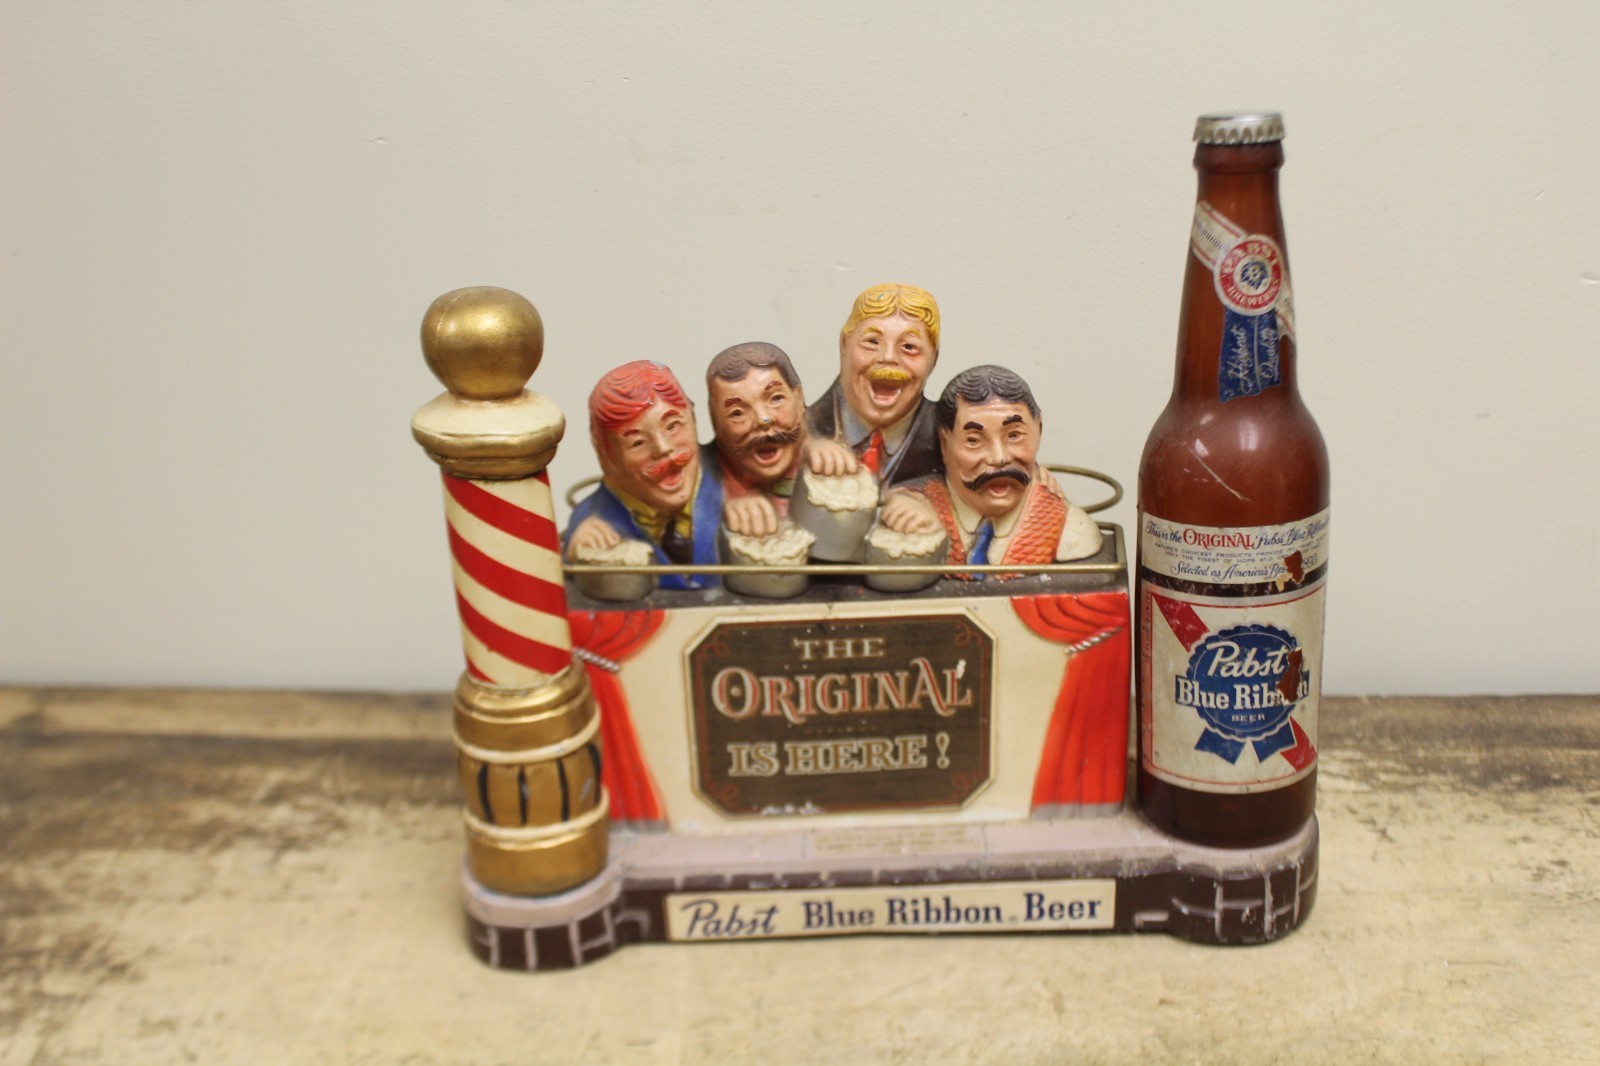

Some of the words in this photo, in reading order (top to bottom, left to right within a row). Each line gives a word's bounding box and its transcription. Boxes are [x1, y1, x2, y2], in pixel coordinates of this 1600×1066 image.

[1170, 530, 1182, 544] the
[1183, 528, 1255, 550] ORIGINAL
[1170, 560, 1209, 577] Selected
[793, 637, 886, 660] THE
[1206, 641, 1289, 678] Pabst
[711, 657, 972, 724] ORIGINAL
[1176, 677, 1230, 710] Blue
[1233, 681, 1308, 711] Ribn
[1231, 713, 1266, 723] BEER
[726, 741, 780, 777] IS
[681, 900, 781, 939] Pabst
[802, 900, 875, 930] Blue
[887, 896, 1004, 926] Ribbon
[1023, 891, 1103, 922] Beer
